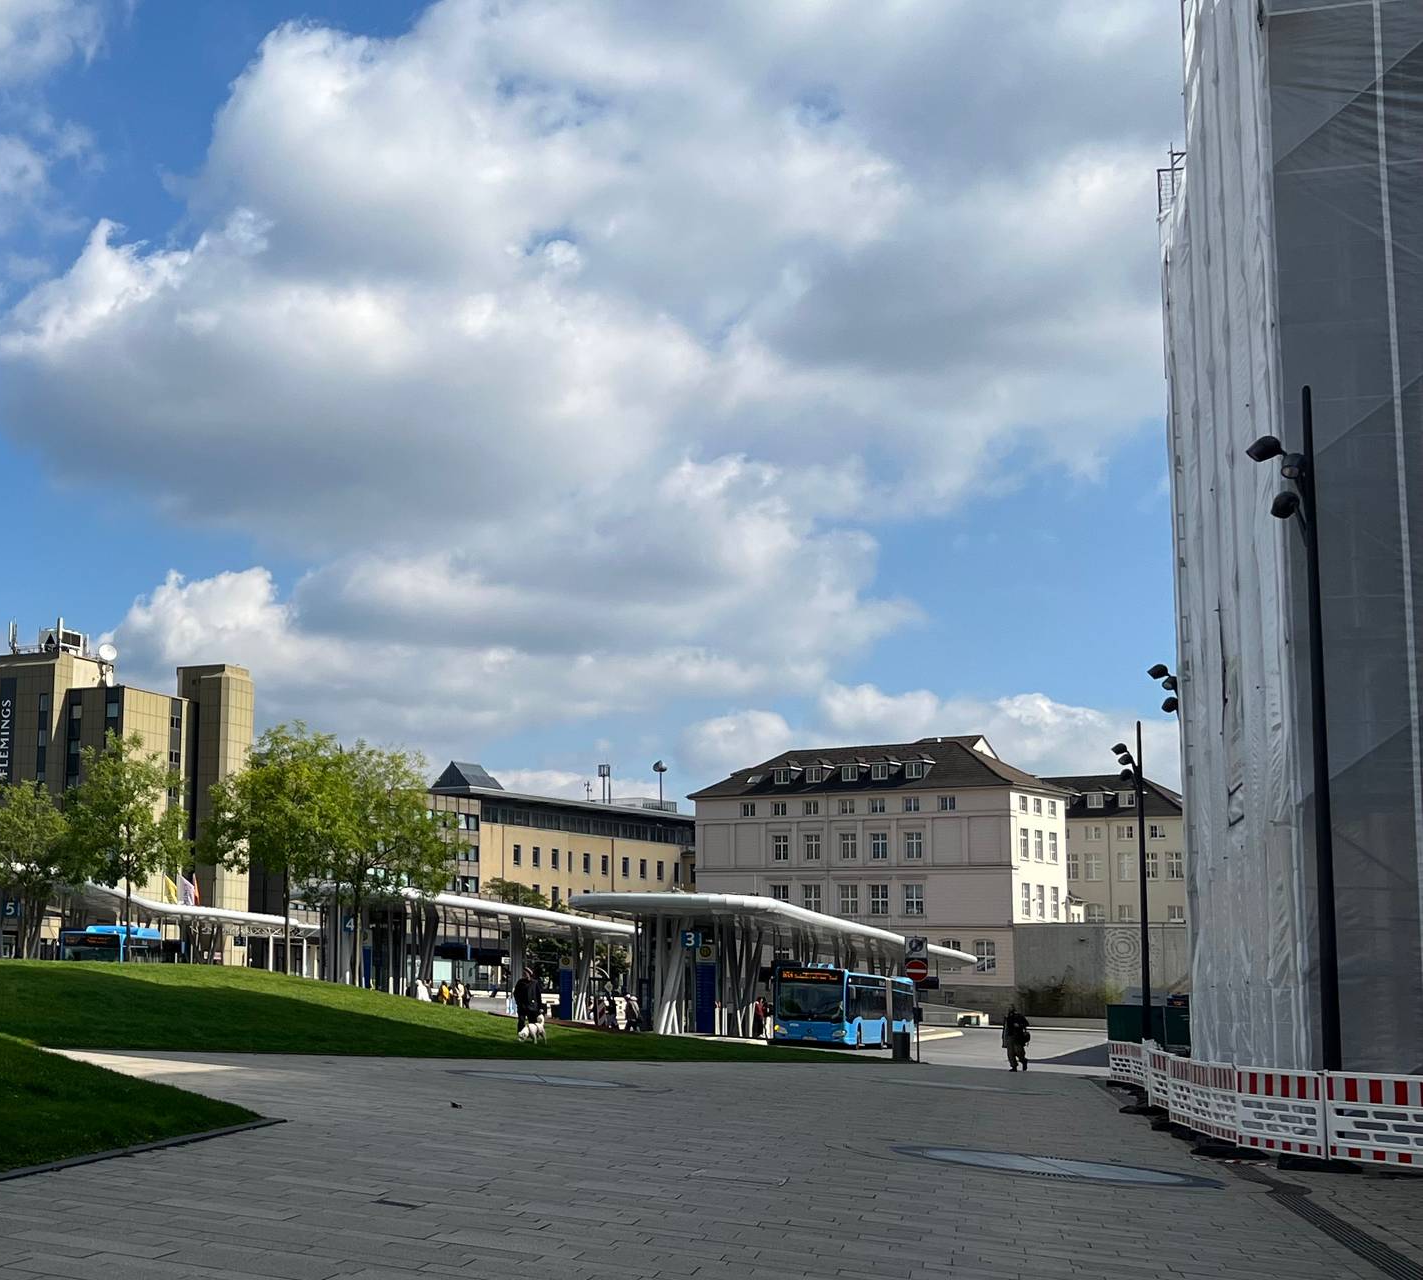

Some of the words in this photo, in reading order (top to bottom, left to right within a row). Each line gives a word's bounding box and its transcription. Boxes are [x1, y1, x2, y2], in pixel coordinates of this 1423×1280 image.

[5, 902, 15, 916] 5
[345, 917, 355, 931] 4
[685, 932, 695, 946] 3
